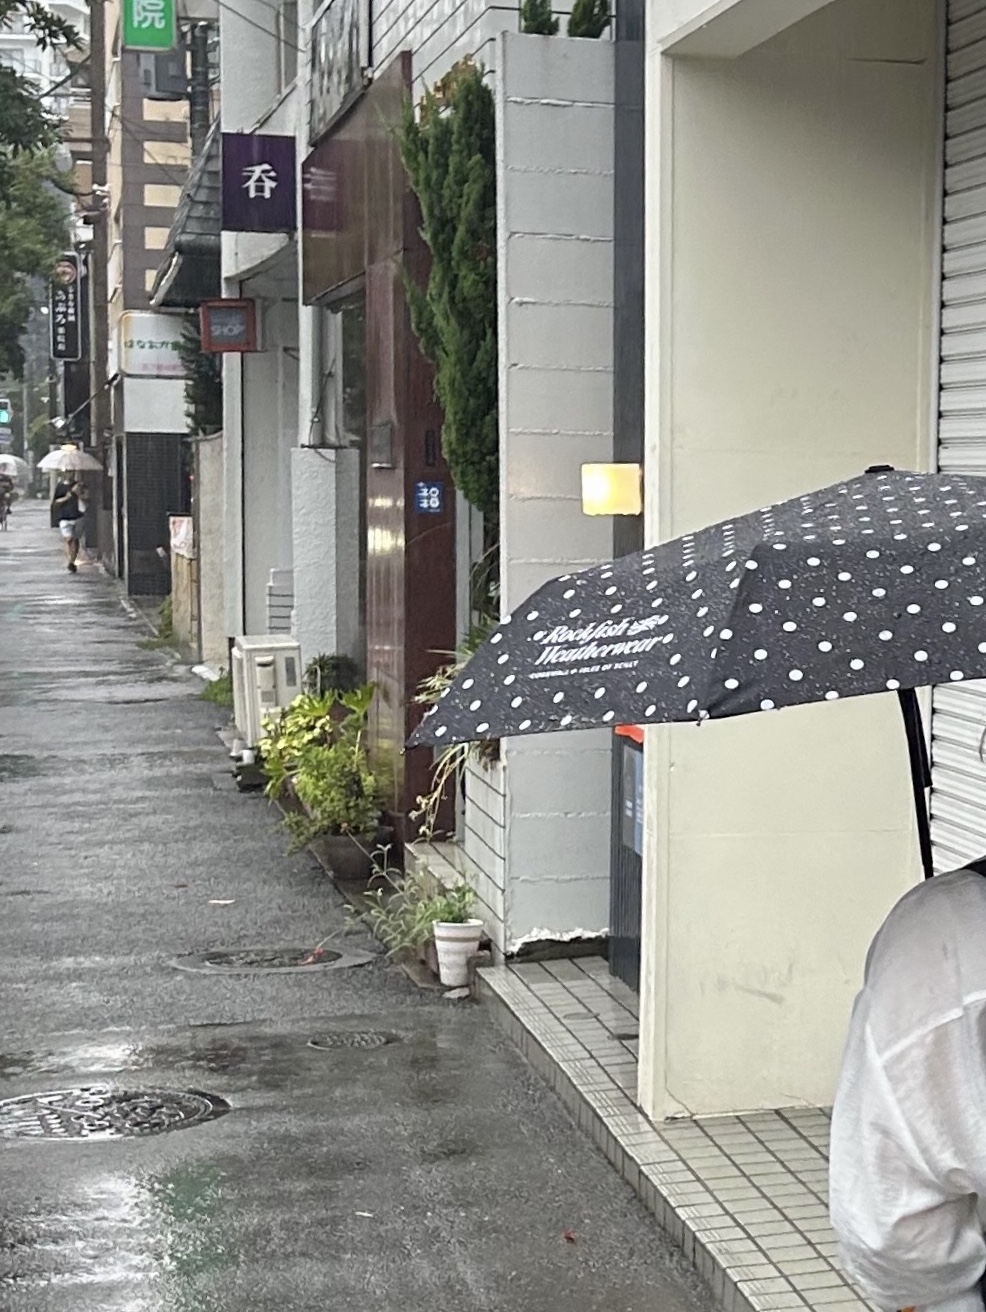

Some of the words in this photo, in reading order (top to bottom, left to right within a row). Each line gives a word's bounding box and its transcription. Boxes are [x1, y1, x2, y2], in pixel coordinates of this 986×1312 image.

[132, 0, 166, 29] 院
[241, 163, 278, 199] 呑
[540, 617, 636, 645] Rockfish
[534, 636, 664, 666] Weatherwear
